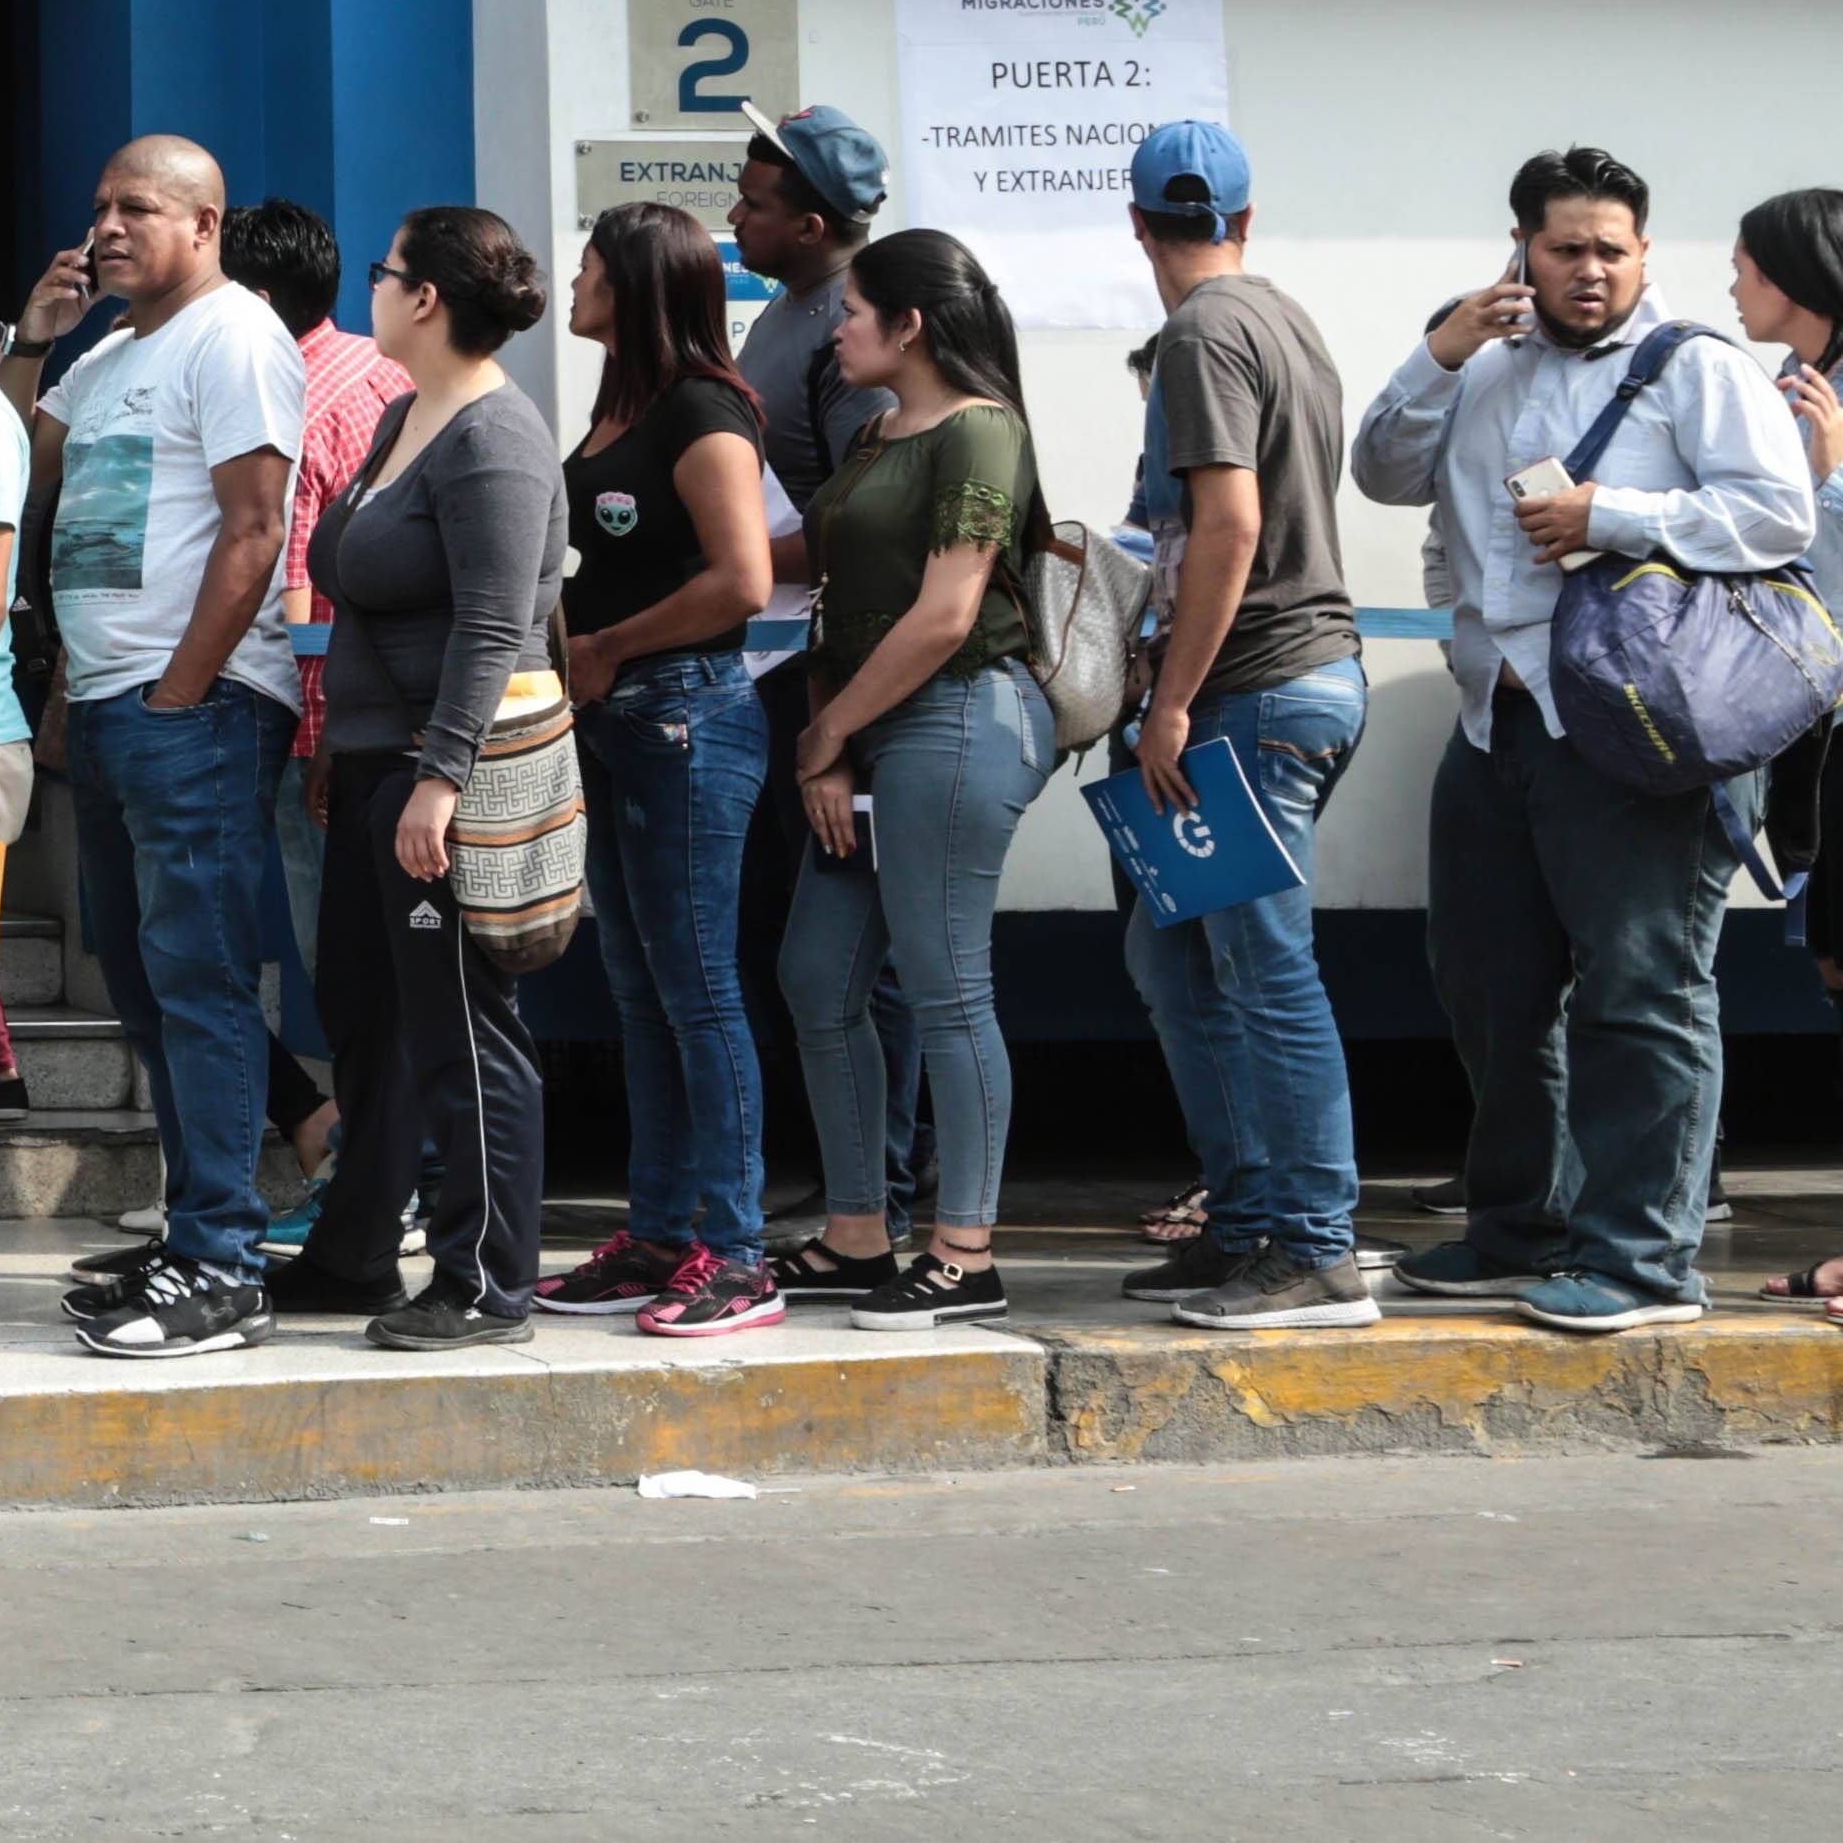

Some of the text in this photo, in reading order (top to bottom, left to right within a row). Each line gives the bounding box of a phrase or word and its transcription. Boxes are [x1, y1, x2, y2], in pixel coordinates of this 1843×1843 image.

[677, 18, 750, 113] 2
[991, 60, 1151, 89] PUERTA 2:
[921, 122, 1160, 148] -TRAMITES NACIO
[620, 162, 743, 183] EXTRANJ
[974, 168, 1132, 192] Y EXTRANJER
[657, 191, 742, 208] FOREIGN
[1623, 683, 1677, 764] SKECHERS
